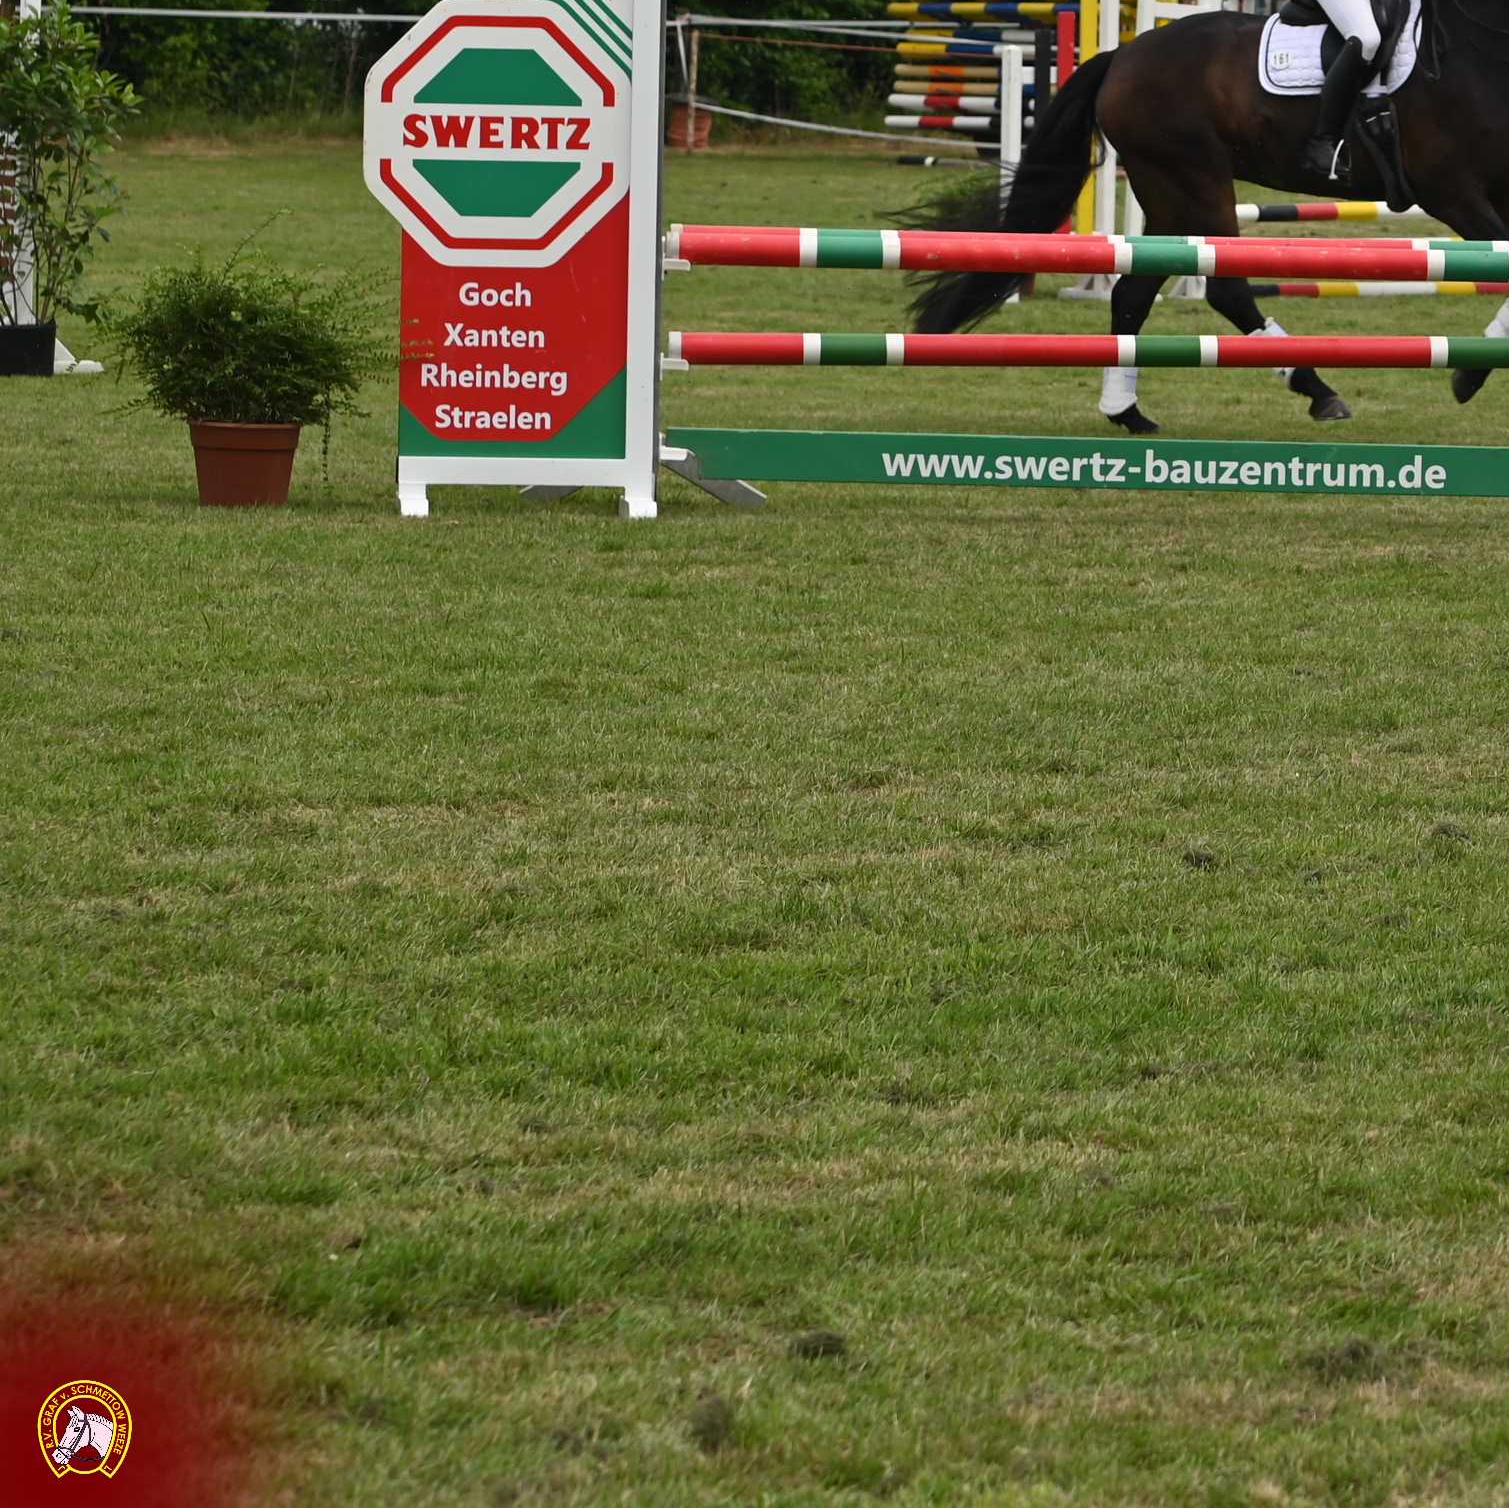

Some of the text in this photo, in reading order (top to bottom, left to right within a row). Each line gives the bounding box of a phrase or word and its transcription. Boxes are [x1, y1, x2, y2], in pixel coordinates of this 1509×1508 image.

[403, 113, 591, 151] SWERTZ
[458, 283, 532, 307] Goch
[444, 323, 545, 348] Xanten
[421, 363, 567, 396] Rheinberg
[435, 405, 551, 430] Straelen
[881, 449, 1447, 489] www.swertz-bauzentrum.de
